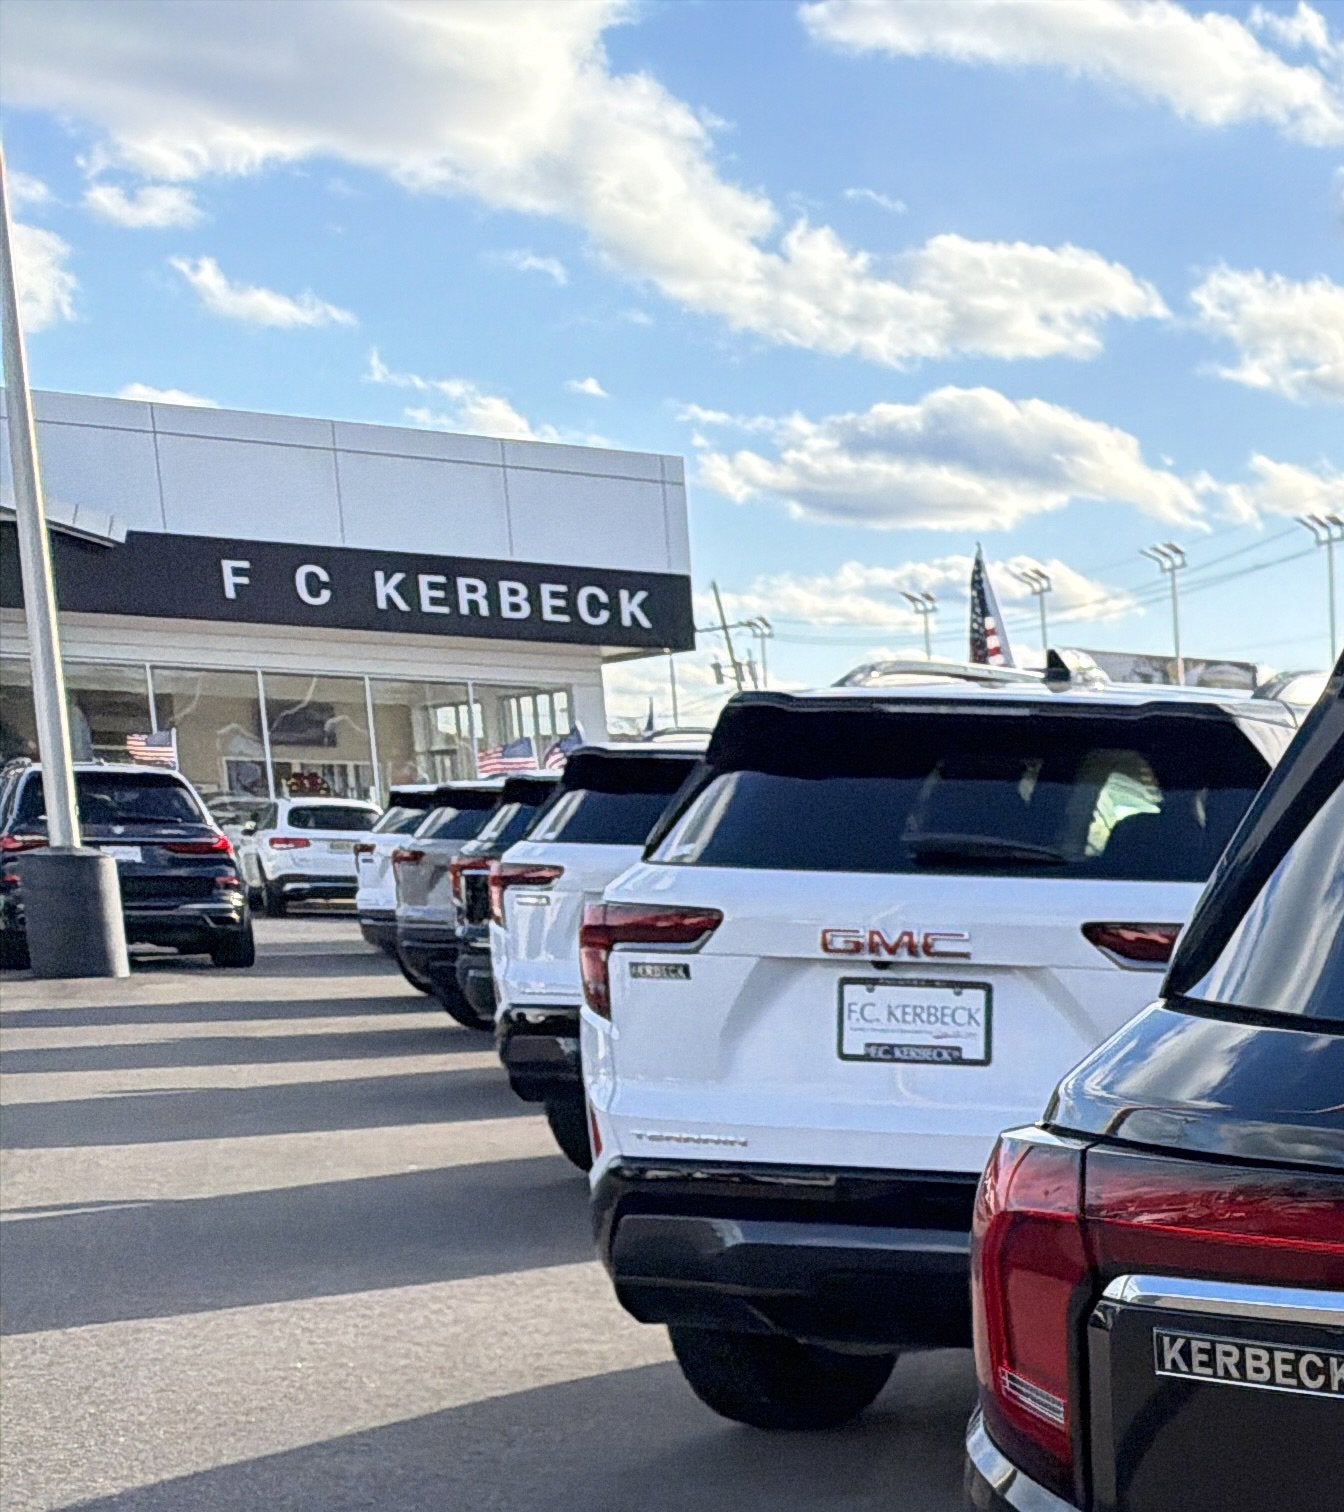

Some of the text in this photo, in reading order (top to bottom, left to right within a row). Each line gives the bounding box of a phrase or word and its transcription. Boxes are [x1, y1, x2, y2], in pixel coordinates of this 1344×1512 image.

[220, 559, 653, 629] F C KERBECK
[820, 928, 971, 960] GMC
[847, 1002, 981, 1028] F.C. KERBECK
